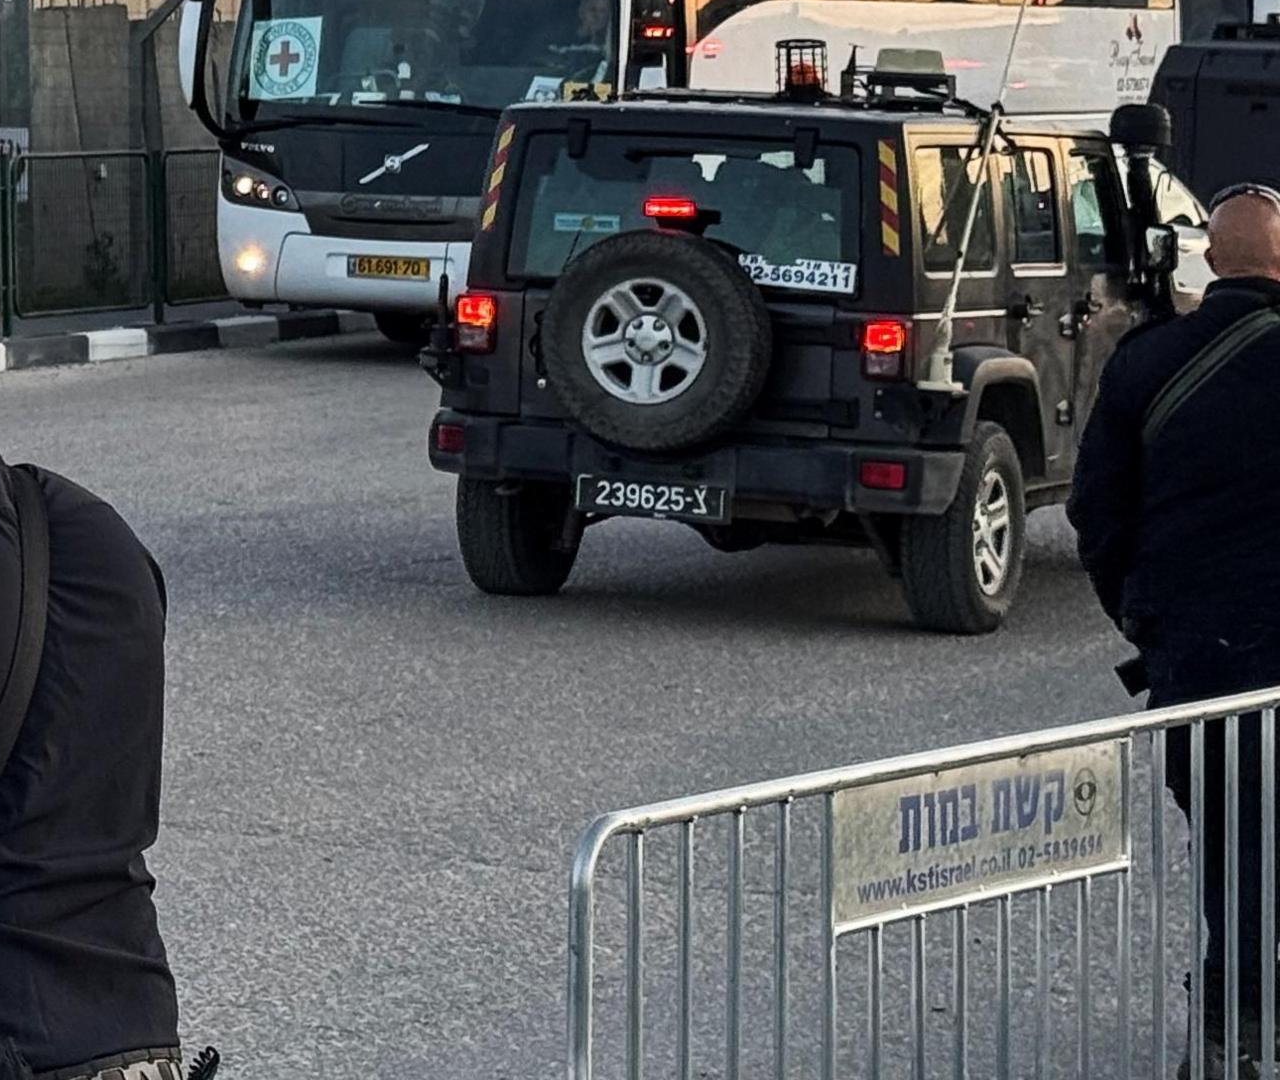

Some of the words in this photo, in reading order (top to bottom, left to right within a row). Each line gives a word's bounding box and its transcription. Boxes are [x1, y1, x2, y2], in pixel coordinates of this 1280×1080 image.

[898, 783, 979, 854] במות
[991, 769, 1066, 835] קשת
[856, 847, 1012, 904] www.kstisrael.co.il
[1018, 833, 1103, 870] 02-5839696
